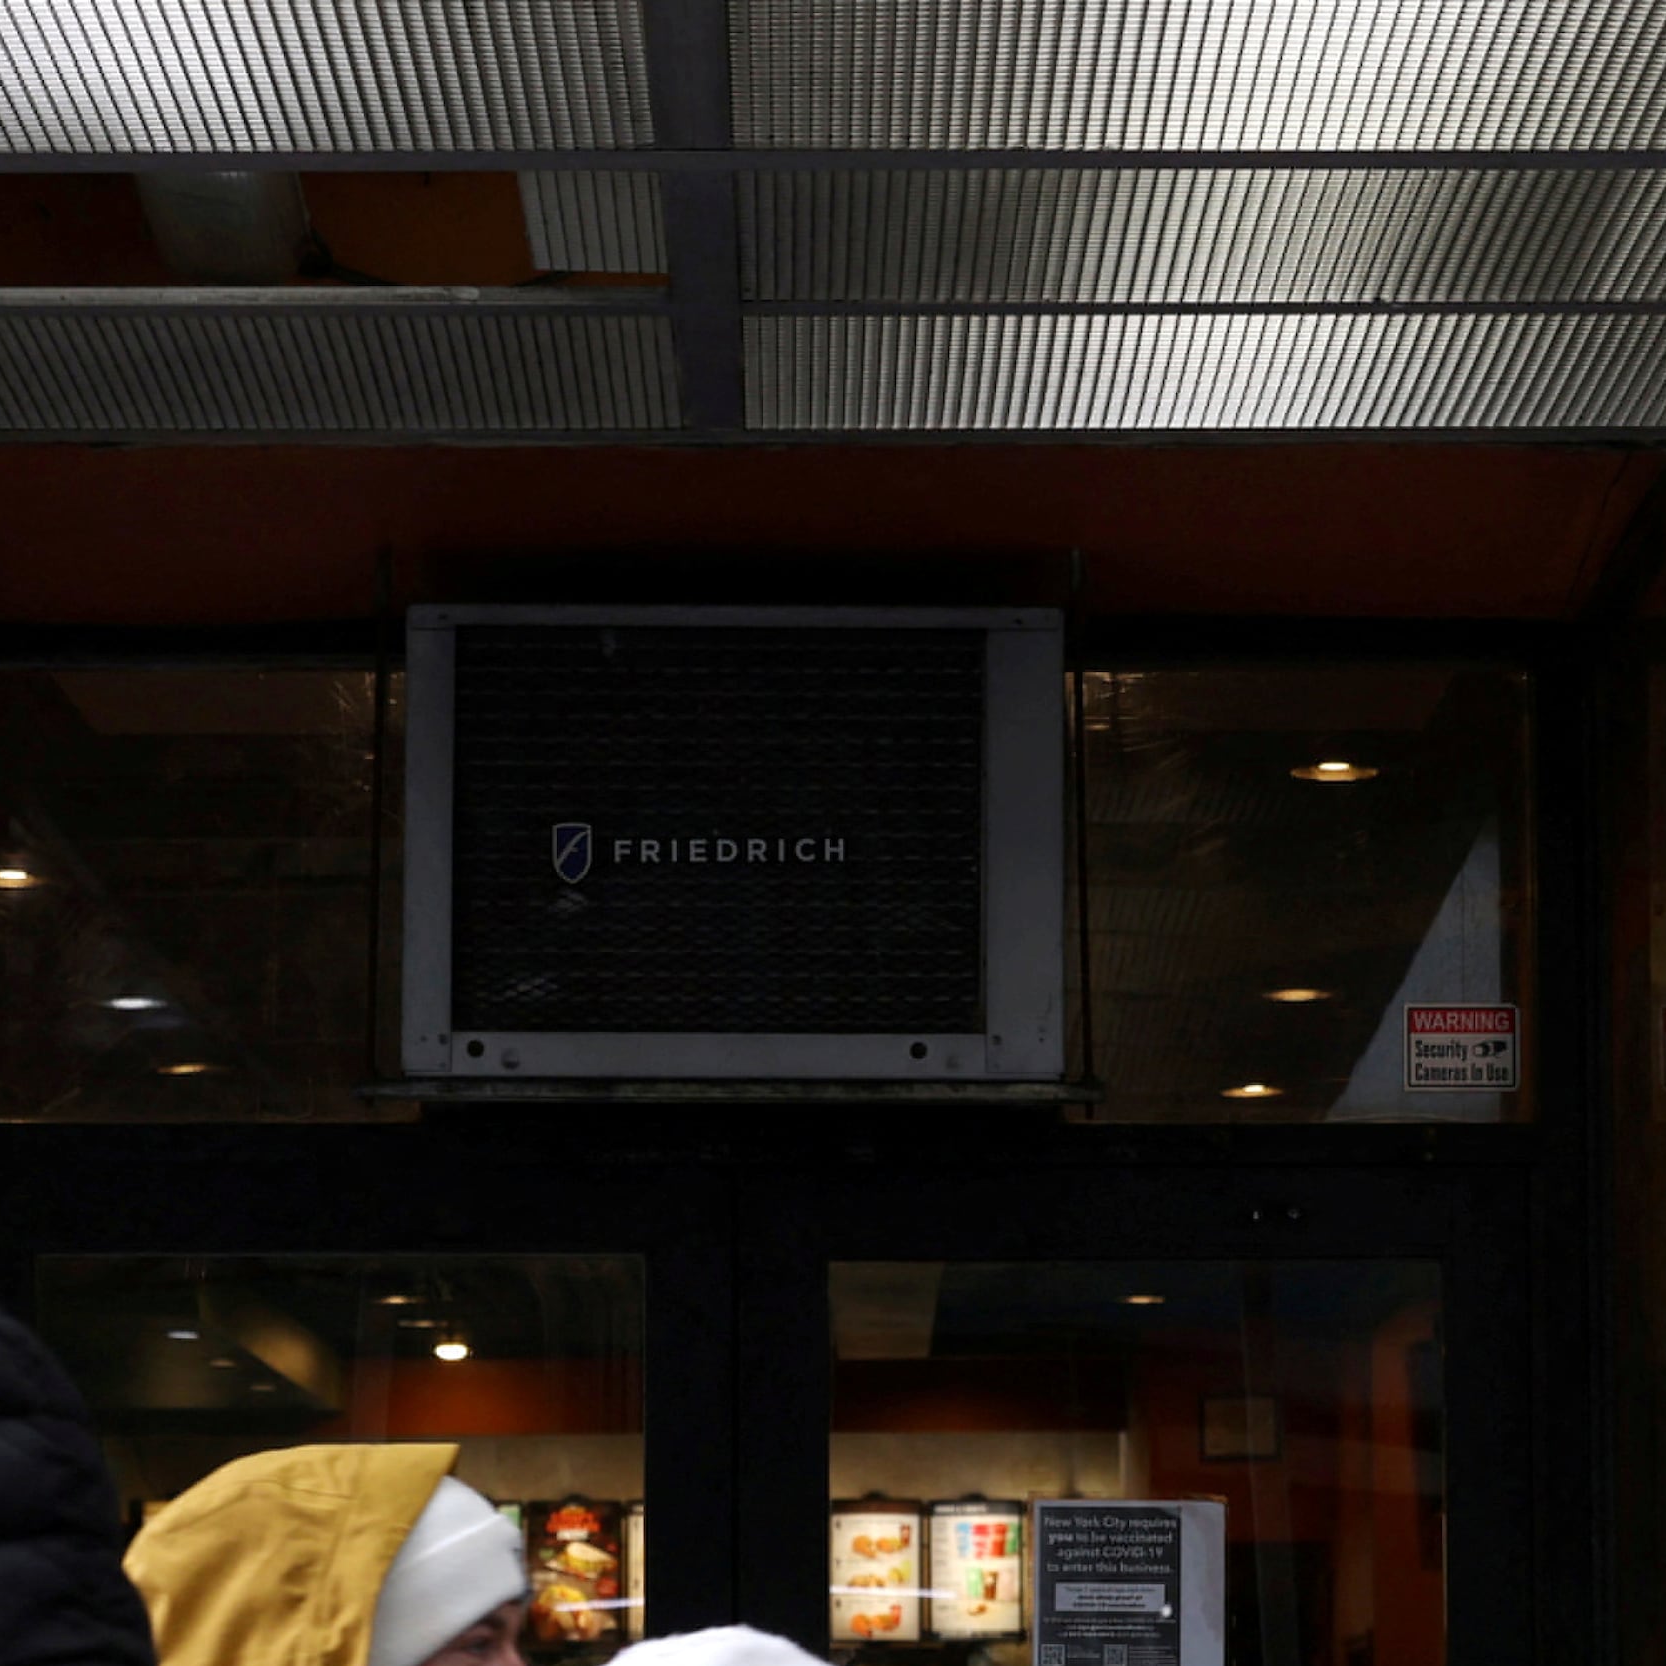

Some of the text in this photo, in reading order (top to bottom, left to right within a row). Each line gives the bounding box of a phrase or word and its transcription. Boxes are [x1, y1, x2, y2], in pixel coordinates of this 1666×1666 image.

[613, 838, 844, 863] FRIEDRICH
[1414, 1011, 1510, 1031] WARNING
[1415, 1039, 1468, 1062] Security
[1415, 1063, 1467, 1081] Cameras
[1486, 1063, 1509, 1081] Use
